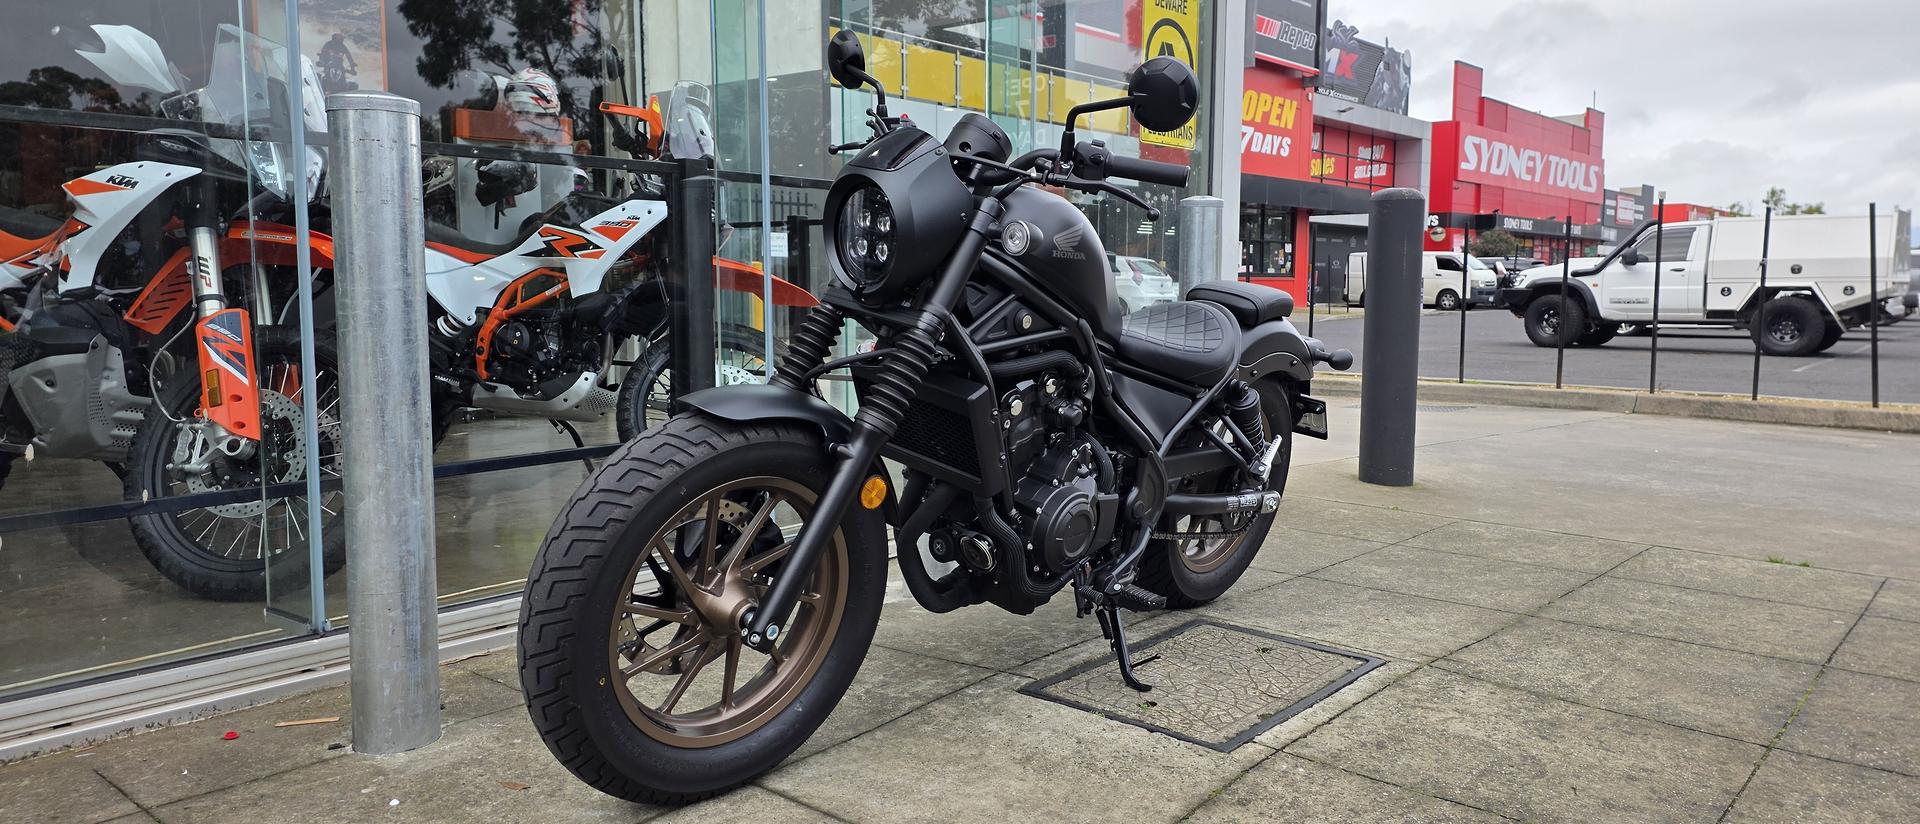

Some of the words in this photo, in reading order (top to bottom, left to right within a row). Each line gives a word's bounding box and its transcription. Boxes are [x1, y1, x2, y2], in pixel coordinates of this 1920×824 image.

[1279, 20, 1317, 51] Repco
[1242, 89, 1297, 129] OPEN
[1310, 155, 1335, 176] soies
[1461, 135, 1547, 182] SYDNEY
[1547, 155, 1600, 193] TOOLS
[105, 174, 140, 189] KTM
[1503, 217, 1520, 229] SYDNEY
[1052, 250, 1087, 261] HONDA
